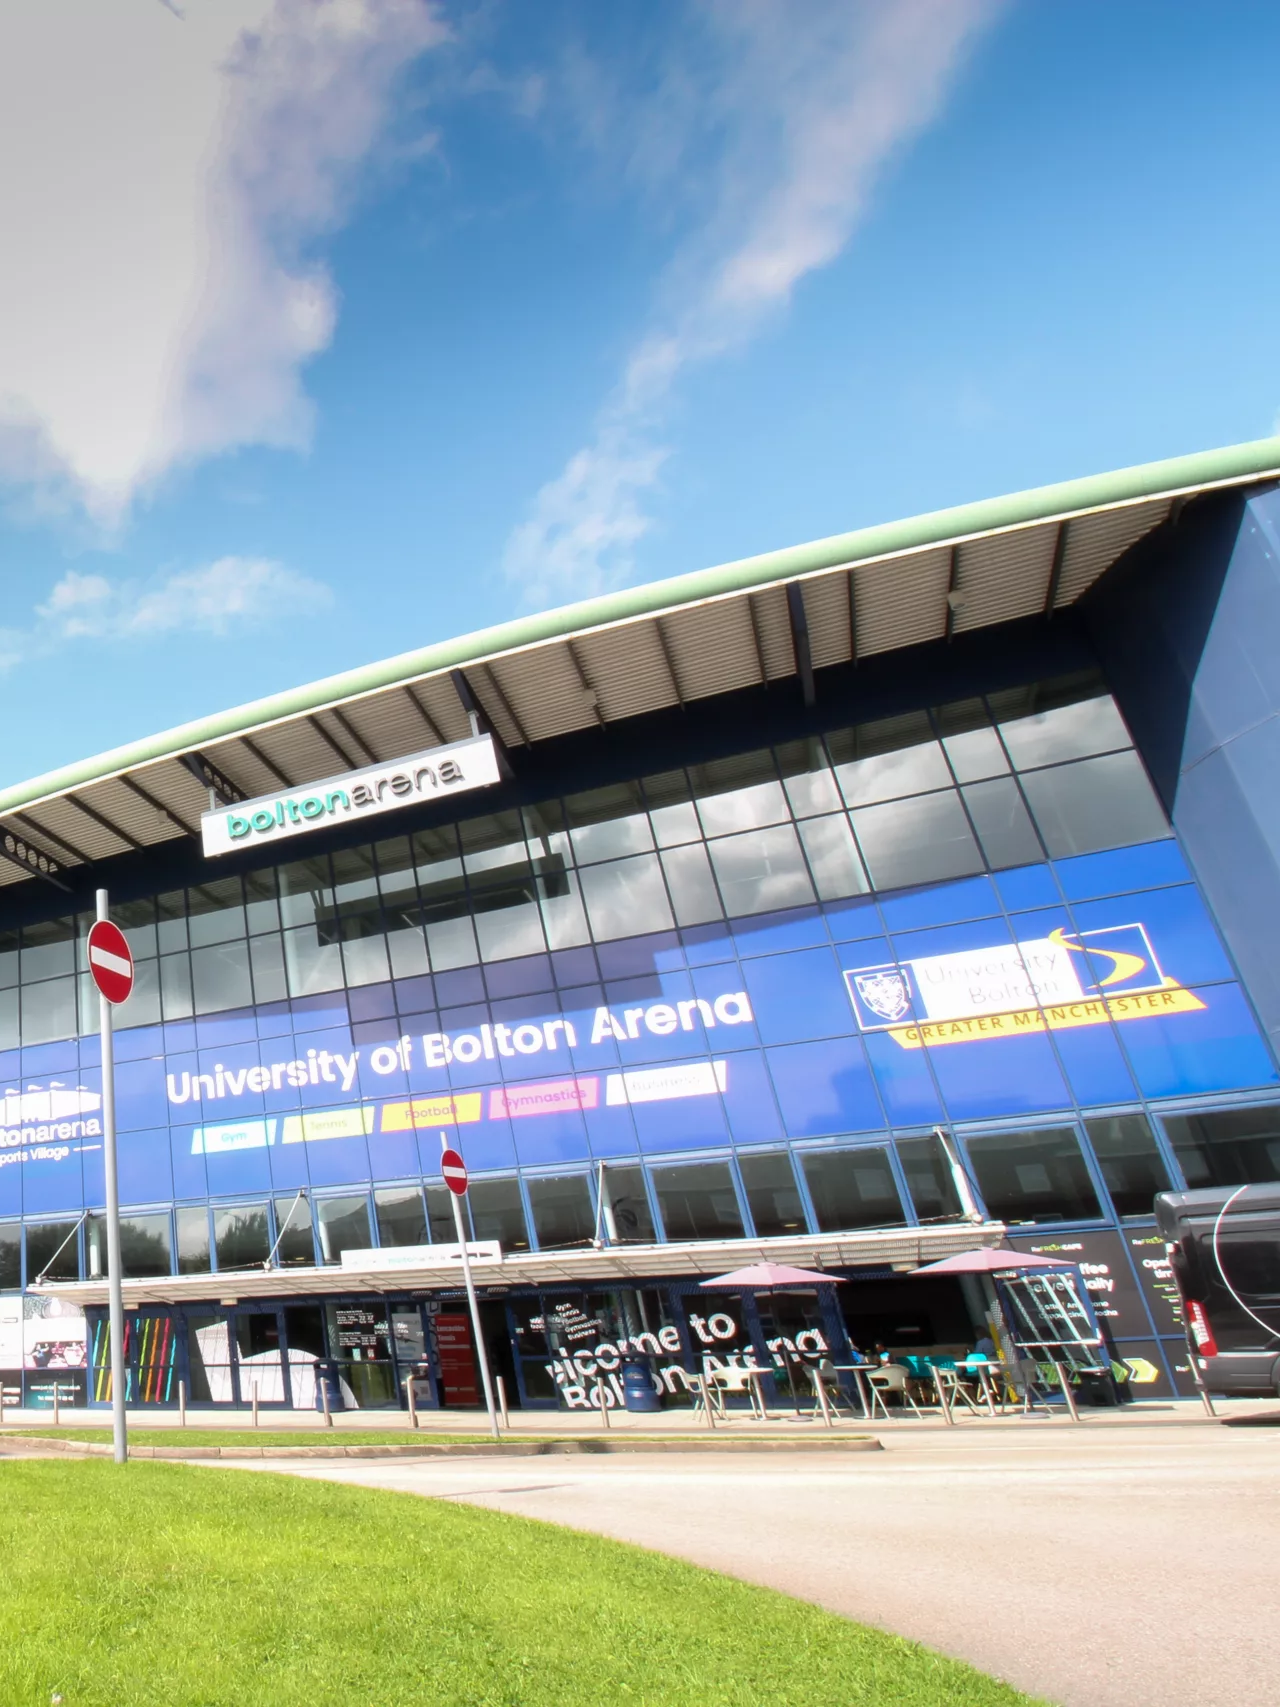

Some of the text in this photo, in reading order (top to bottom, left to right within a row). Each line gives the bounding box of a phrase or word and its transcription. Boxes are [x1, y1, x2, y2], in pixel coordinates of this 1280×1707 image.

[227, 758, 465, 840] boltonarena
[905, 992, 1176, 1042] GREATER MANCHESTER
[166, 991, 753, 1104] University of Bolton Arena
[405, 1103, 458, 1120] Football
[501, 1088, 587, 1110] Gymnastics
[221, 1132, 247, 1145] Gym
[29, 1145, 69, 1161] Village
[689, 1313, 736, 1343] to
